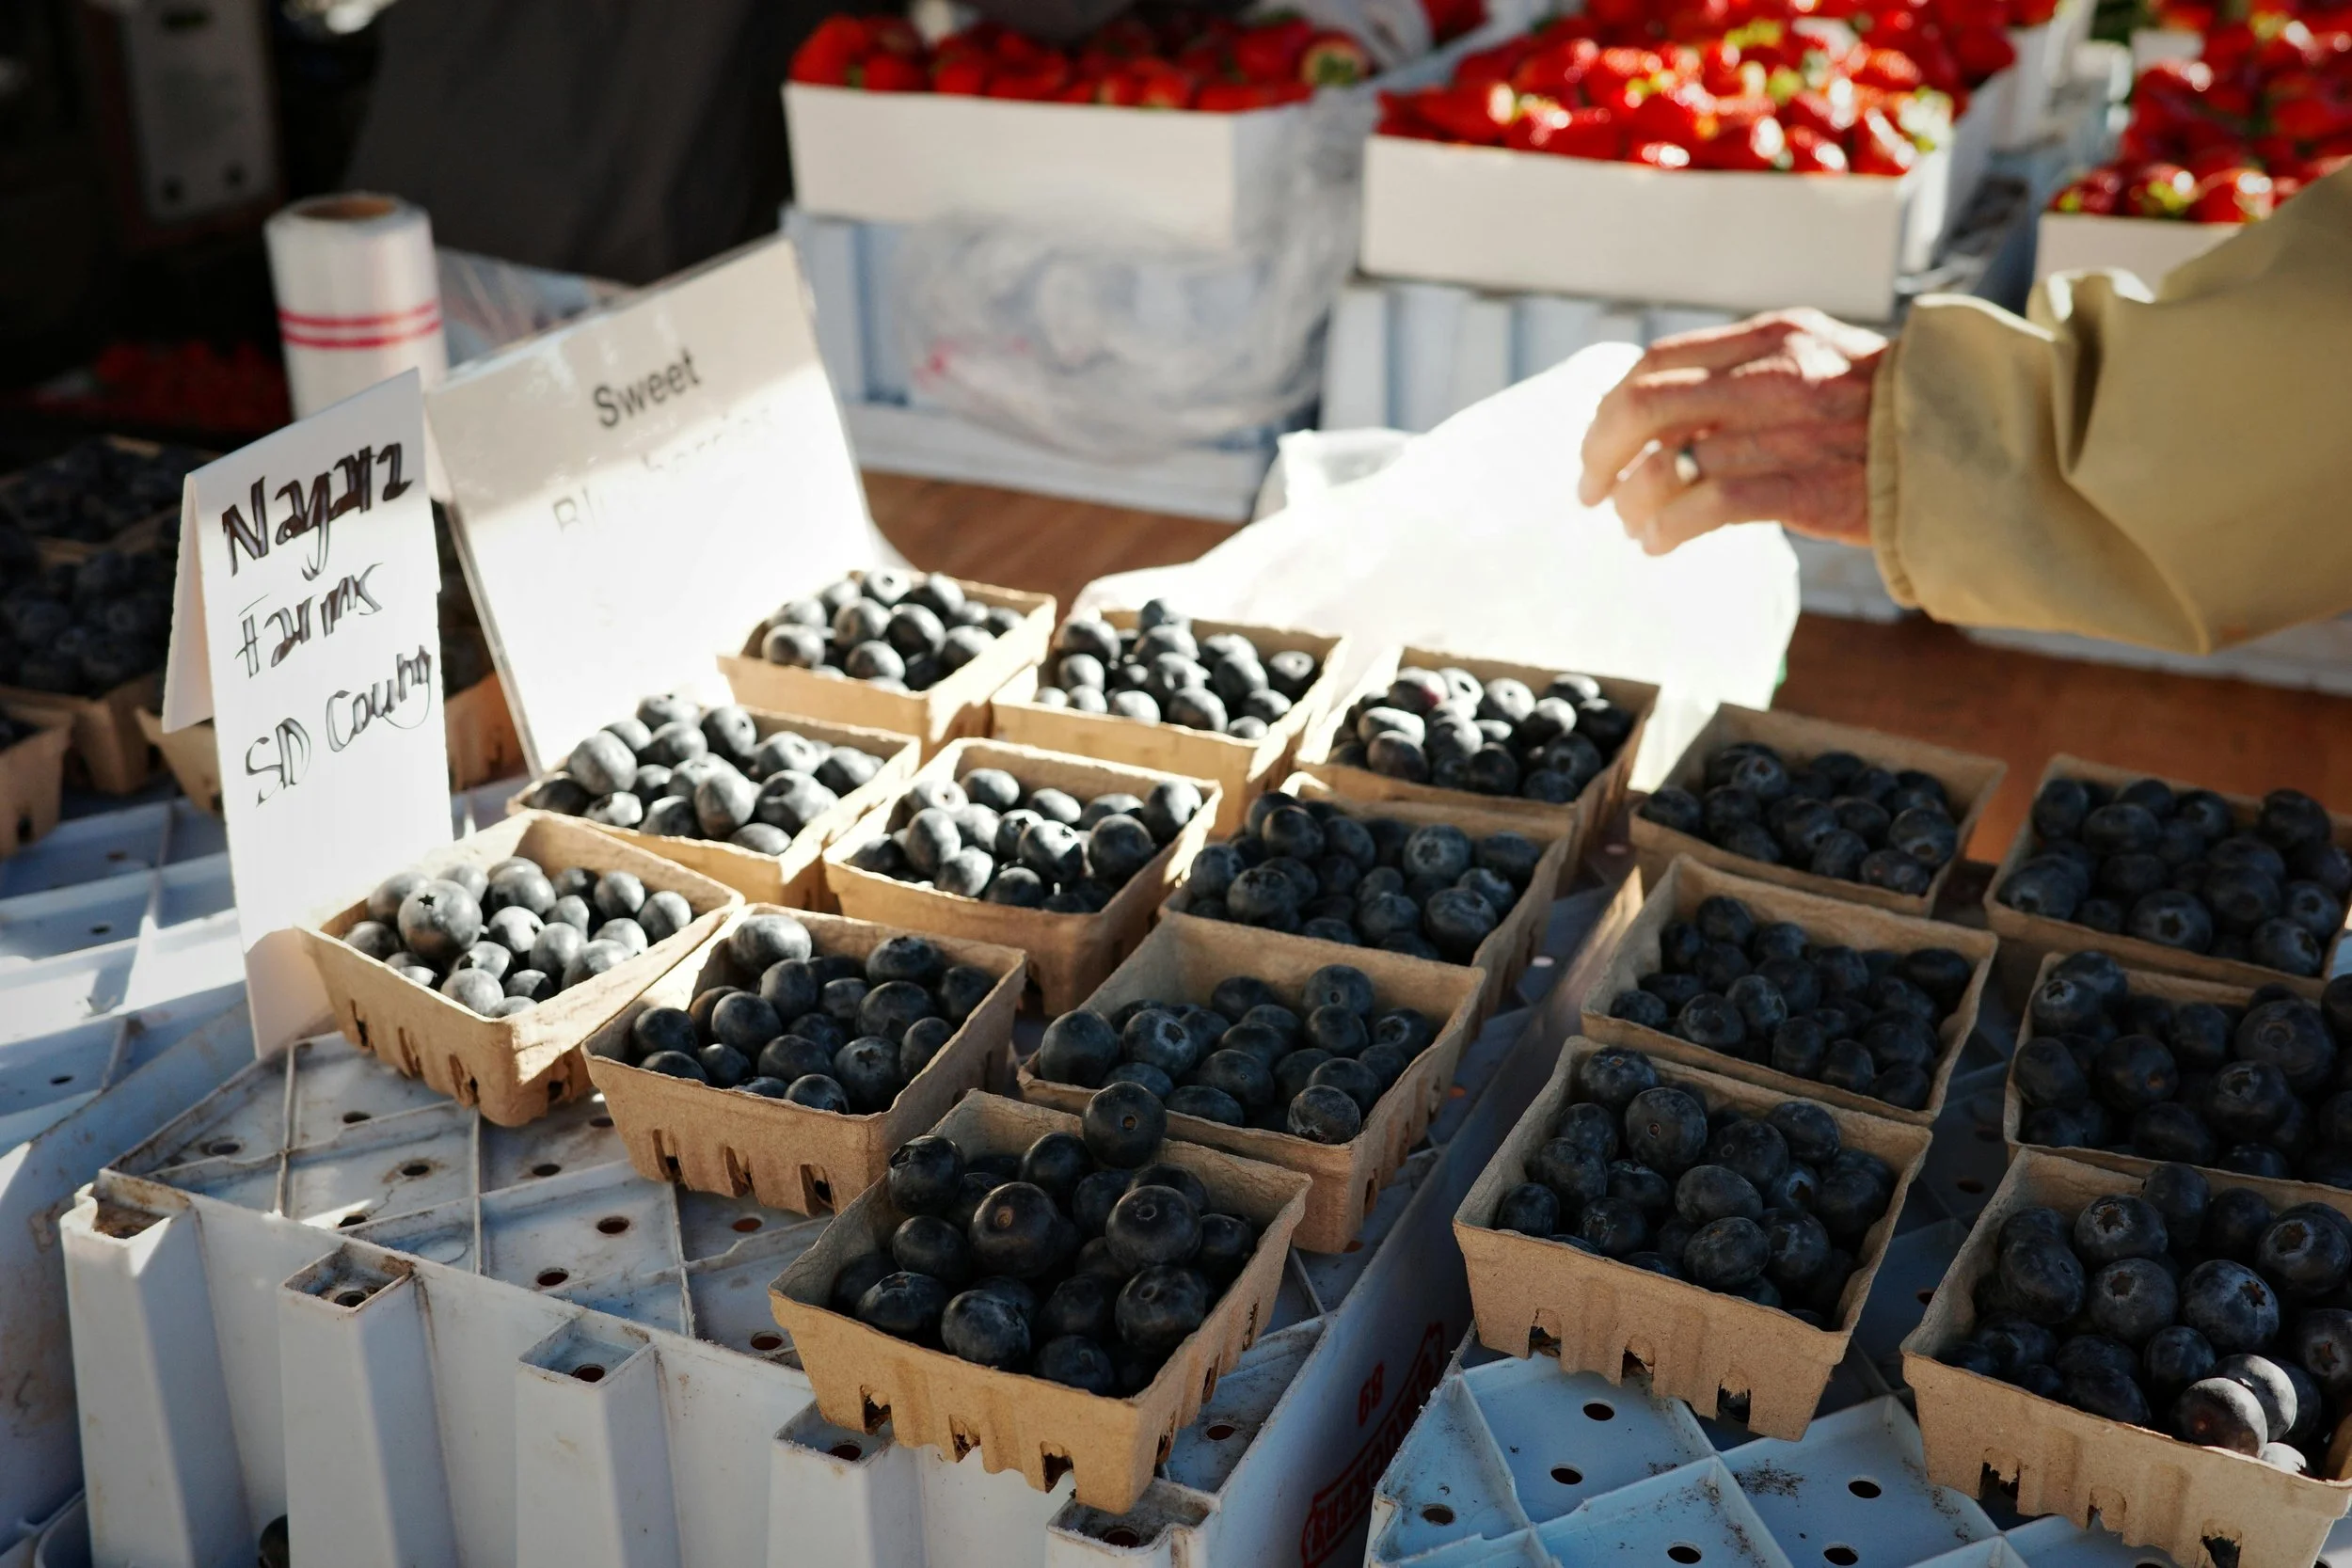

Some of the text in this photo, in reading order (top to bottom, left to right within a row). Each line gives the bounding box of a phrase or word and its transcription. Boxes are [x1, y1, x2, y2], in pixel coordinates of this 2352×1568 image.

[591, 345, 702, 428] Sweet
[234, 562, 384, 679] Farms
[245, 717, 311, 808] SD
